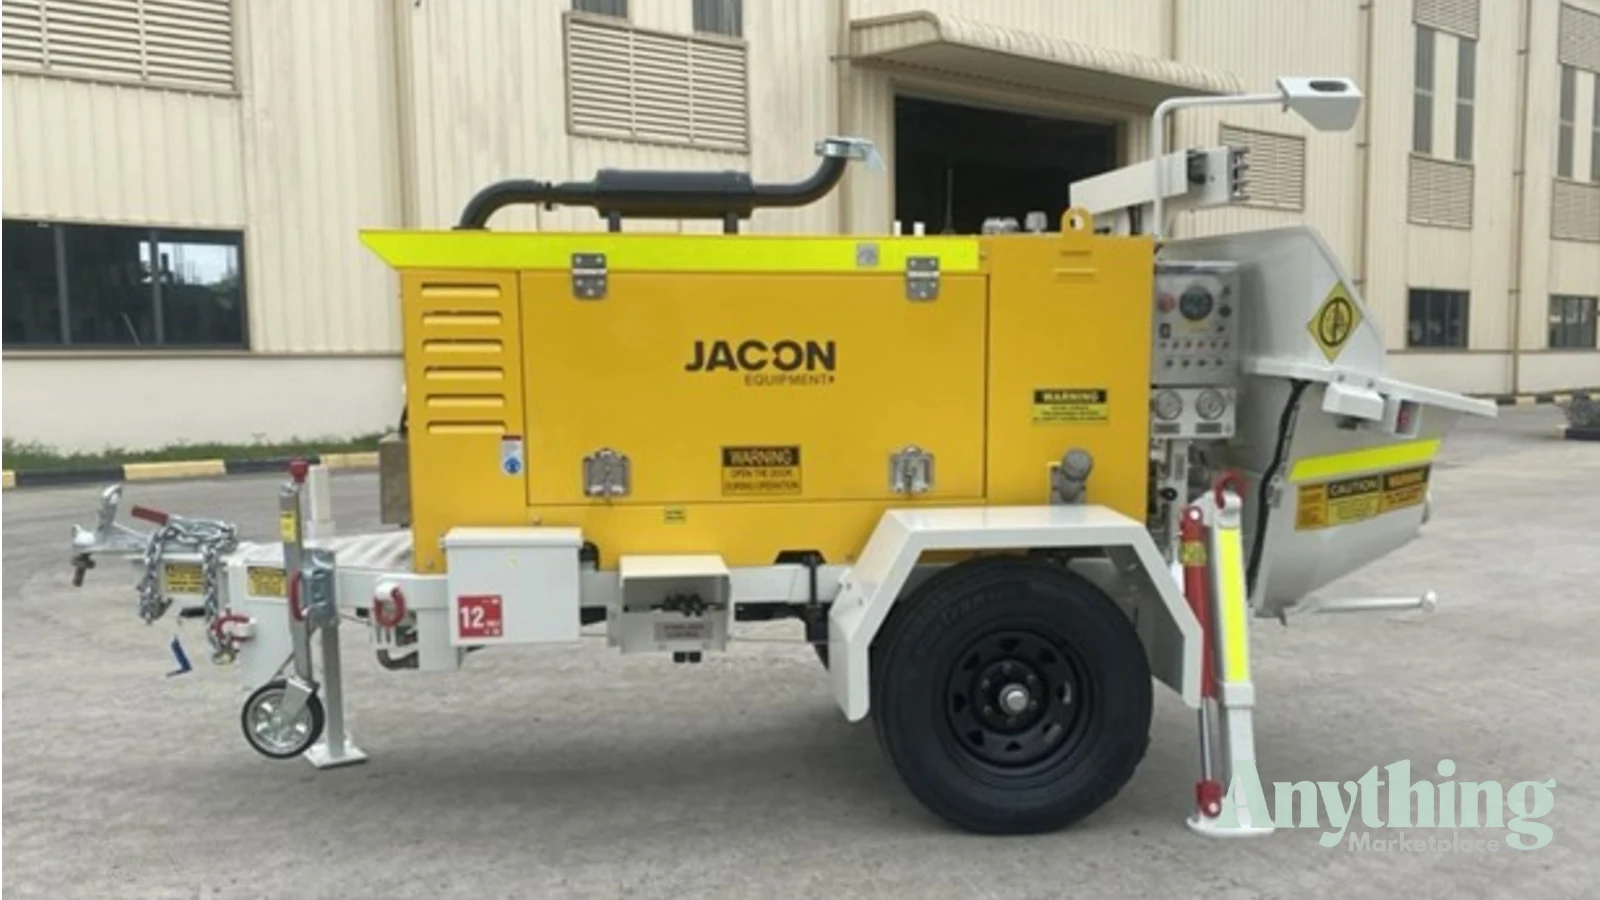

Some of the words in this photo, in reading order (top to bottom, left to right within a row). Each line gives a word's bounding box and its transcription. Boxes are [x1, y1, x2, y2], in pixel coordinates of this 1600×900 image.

[684, 340, 836, 371] JACON
[744, 374, 828, 386] EQUIPMENT
[1043, 391, 1100, 402] WARNING
[730, 449, 793, 465] WARNING
[1330, 479, 1378, 496] CAUTION
[460, 606, 484, 628] 12
